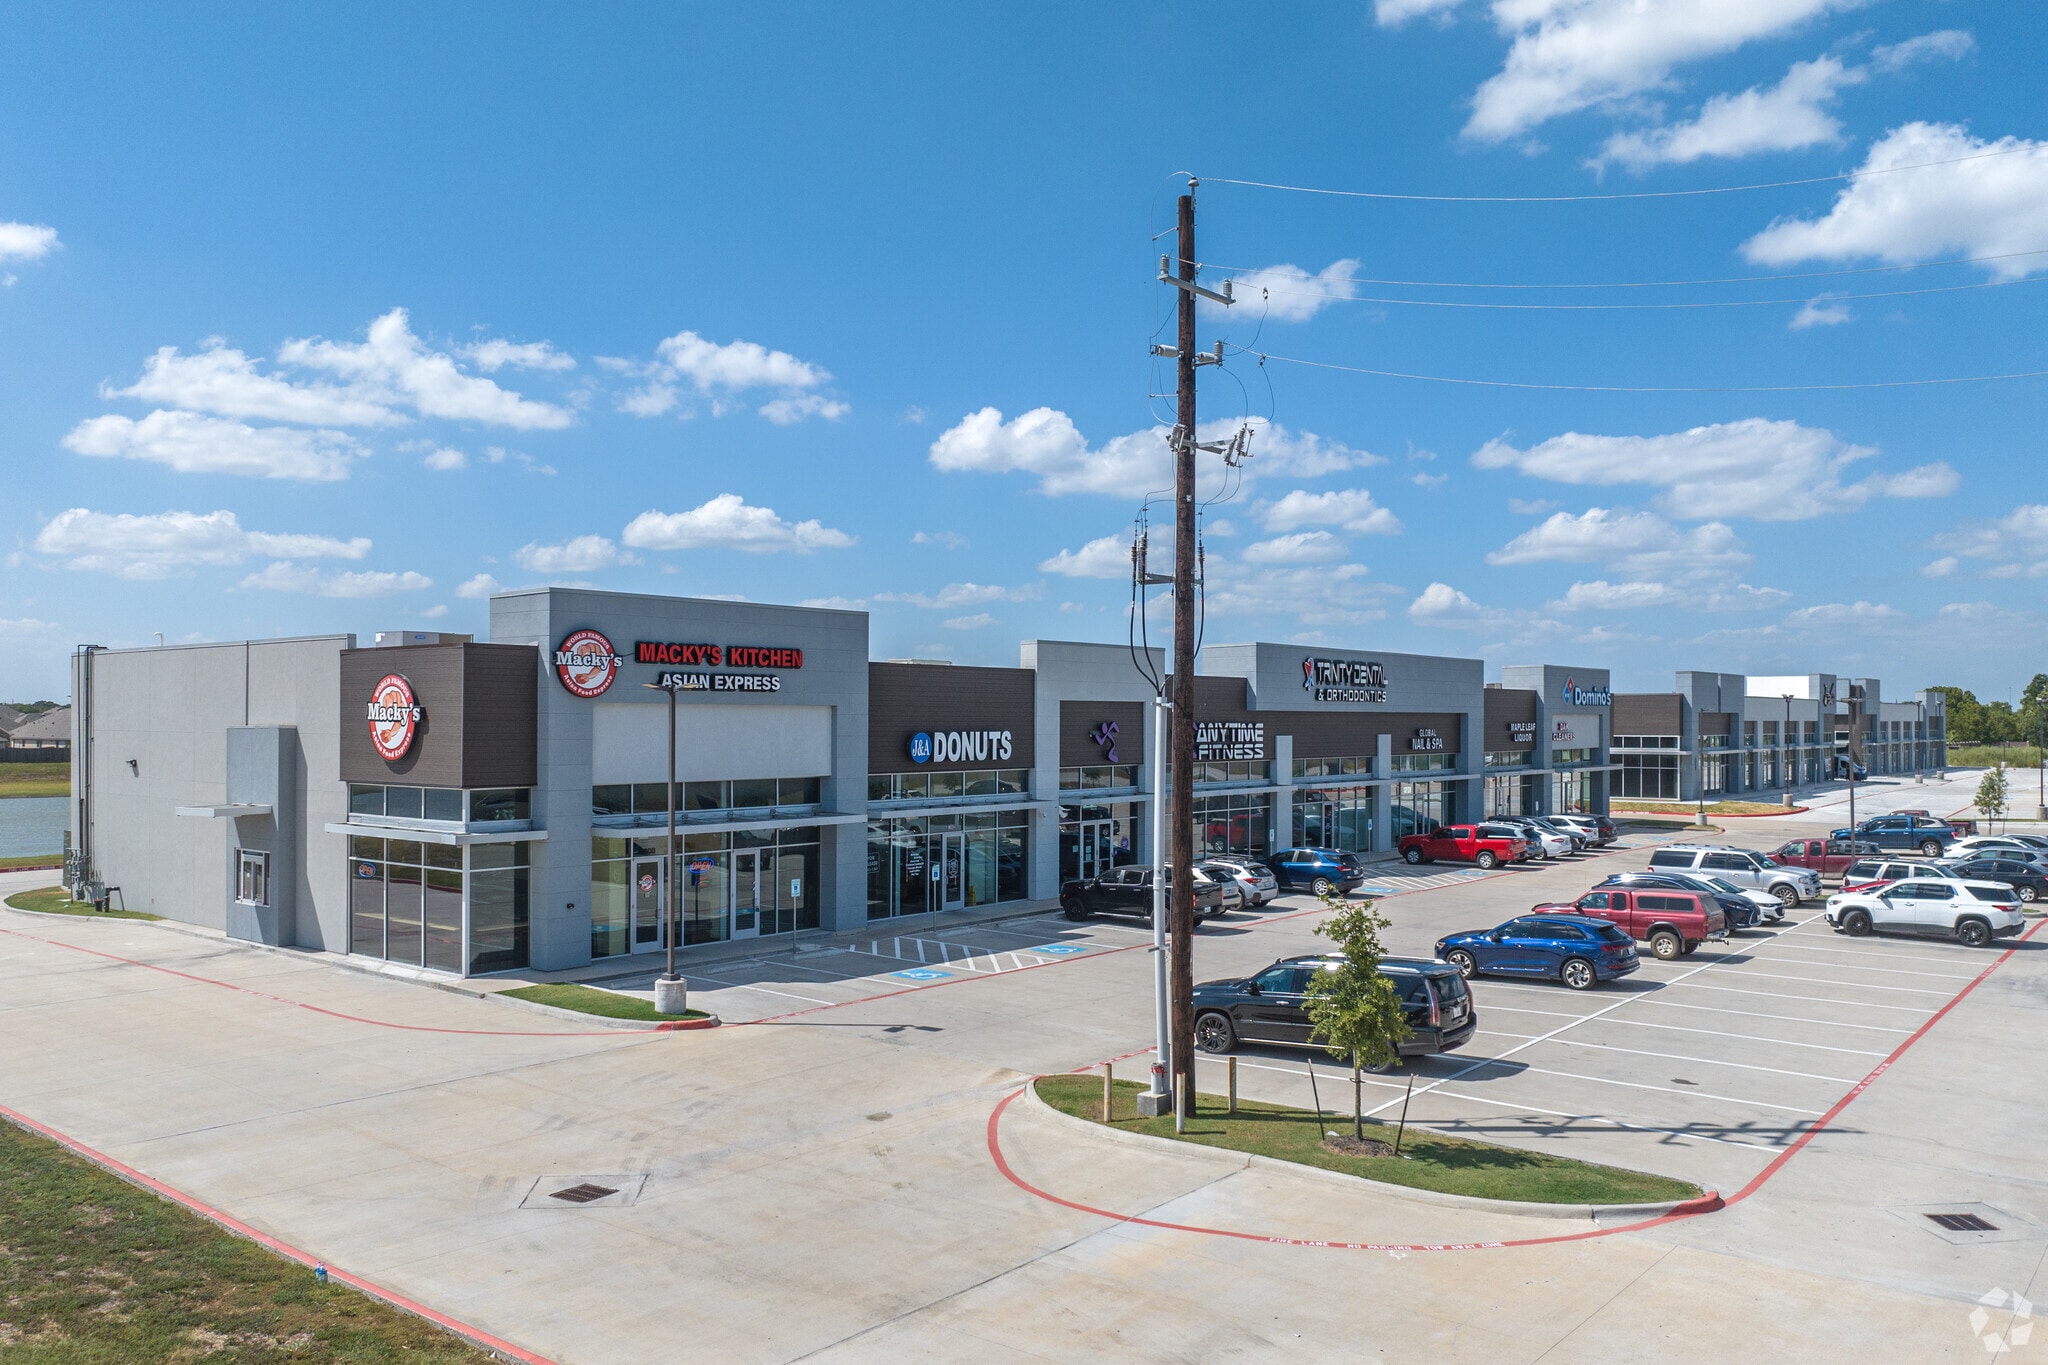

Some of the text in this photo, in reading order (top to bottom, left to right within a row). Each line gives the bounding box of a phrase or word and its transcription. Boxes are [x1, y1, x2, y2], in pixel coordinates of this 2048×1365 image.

[566, 632, 610, 650] WORLD FAMOUS
[555, 651, 623, 670] Macky's
[639, 643, 803, 667] MACKY'S KITCHEN
[661, 673, 781, 690] ASIAN EXPRESS
[1318, 689, 1387, 702] & ORTHODONTICS
[1574, 687, 1612, 706] Domino's
[367, 702, 420, 726] Macky's
[1196, 722, 1264, 742] ANYTIME
[1419, 729, 1437, 737] GLOBAL
[912, 730, 1012, 762] J&A DONUTS
[1198, 743, 1264, 760] FITNESS
[1412, 738, 1425, 750] NAIL
[1431, 738, 1443, 750] SPA
[691, 861, 712, 871] OPEN
